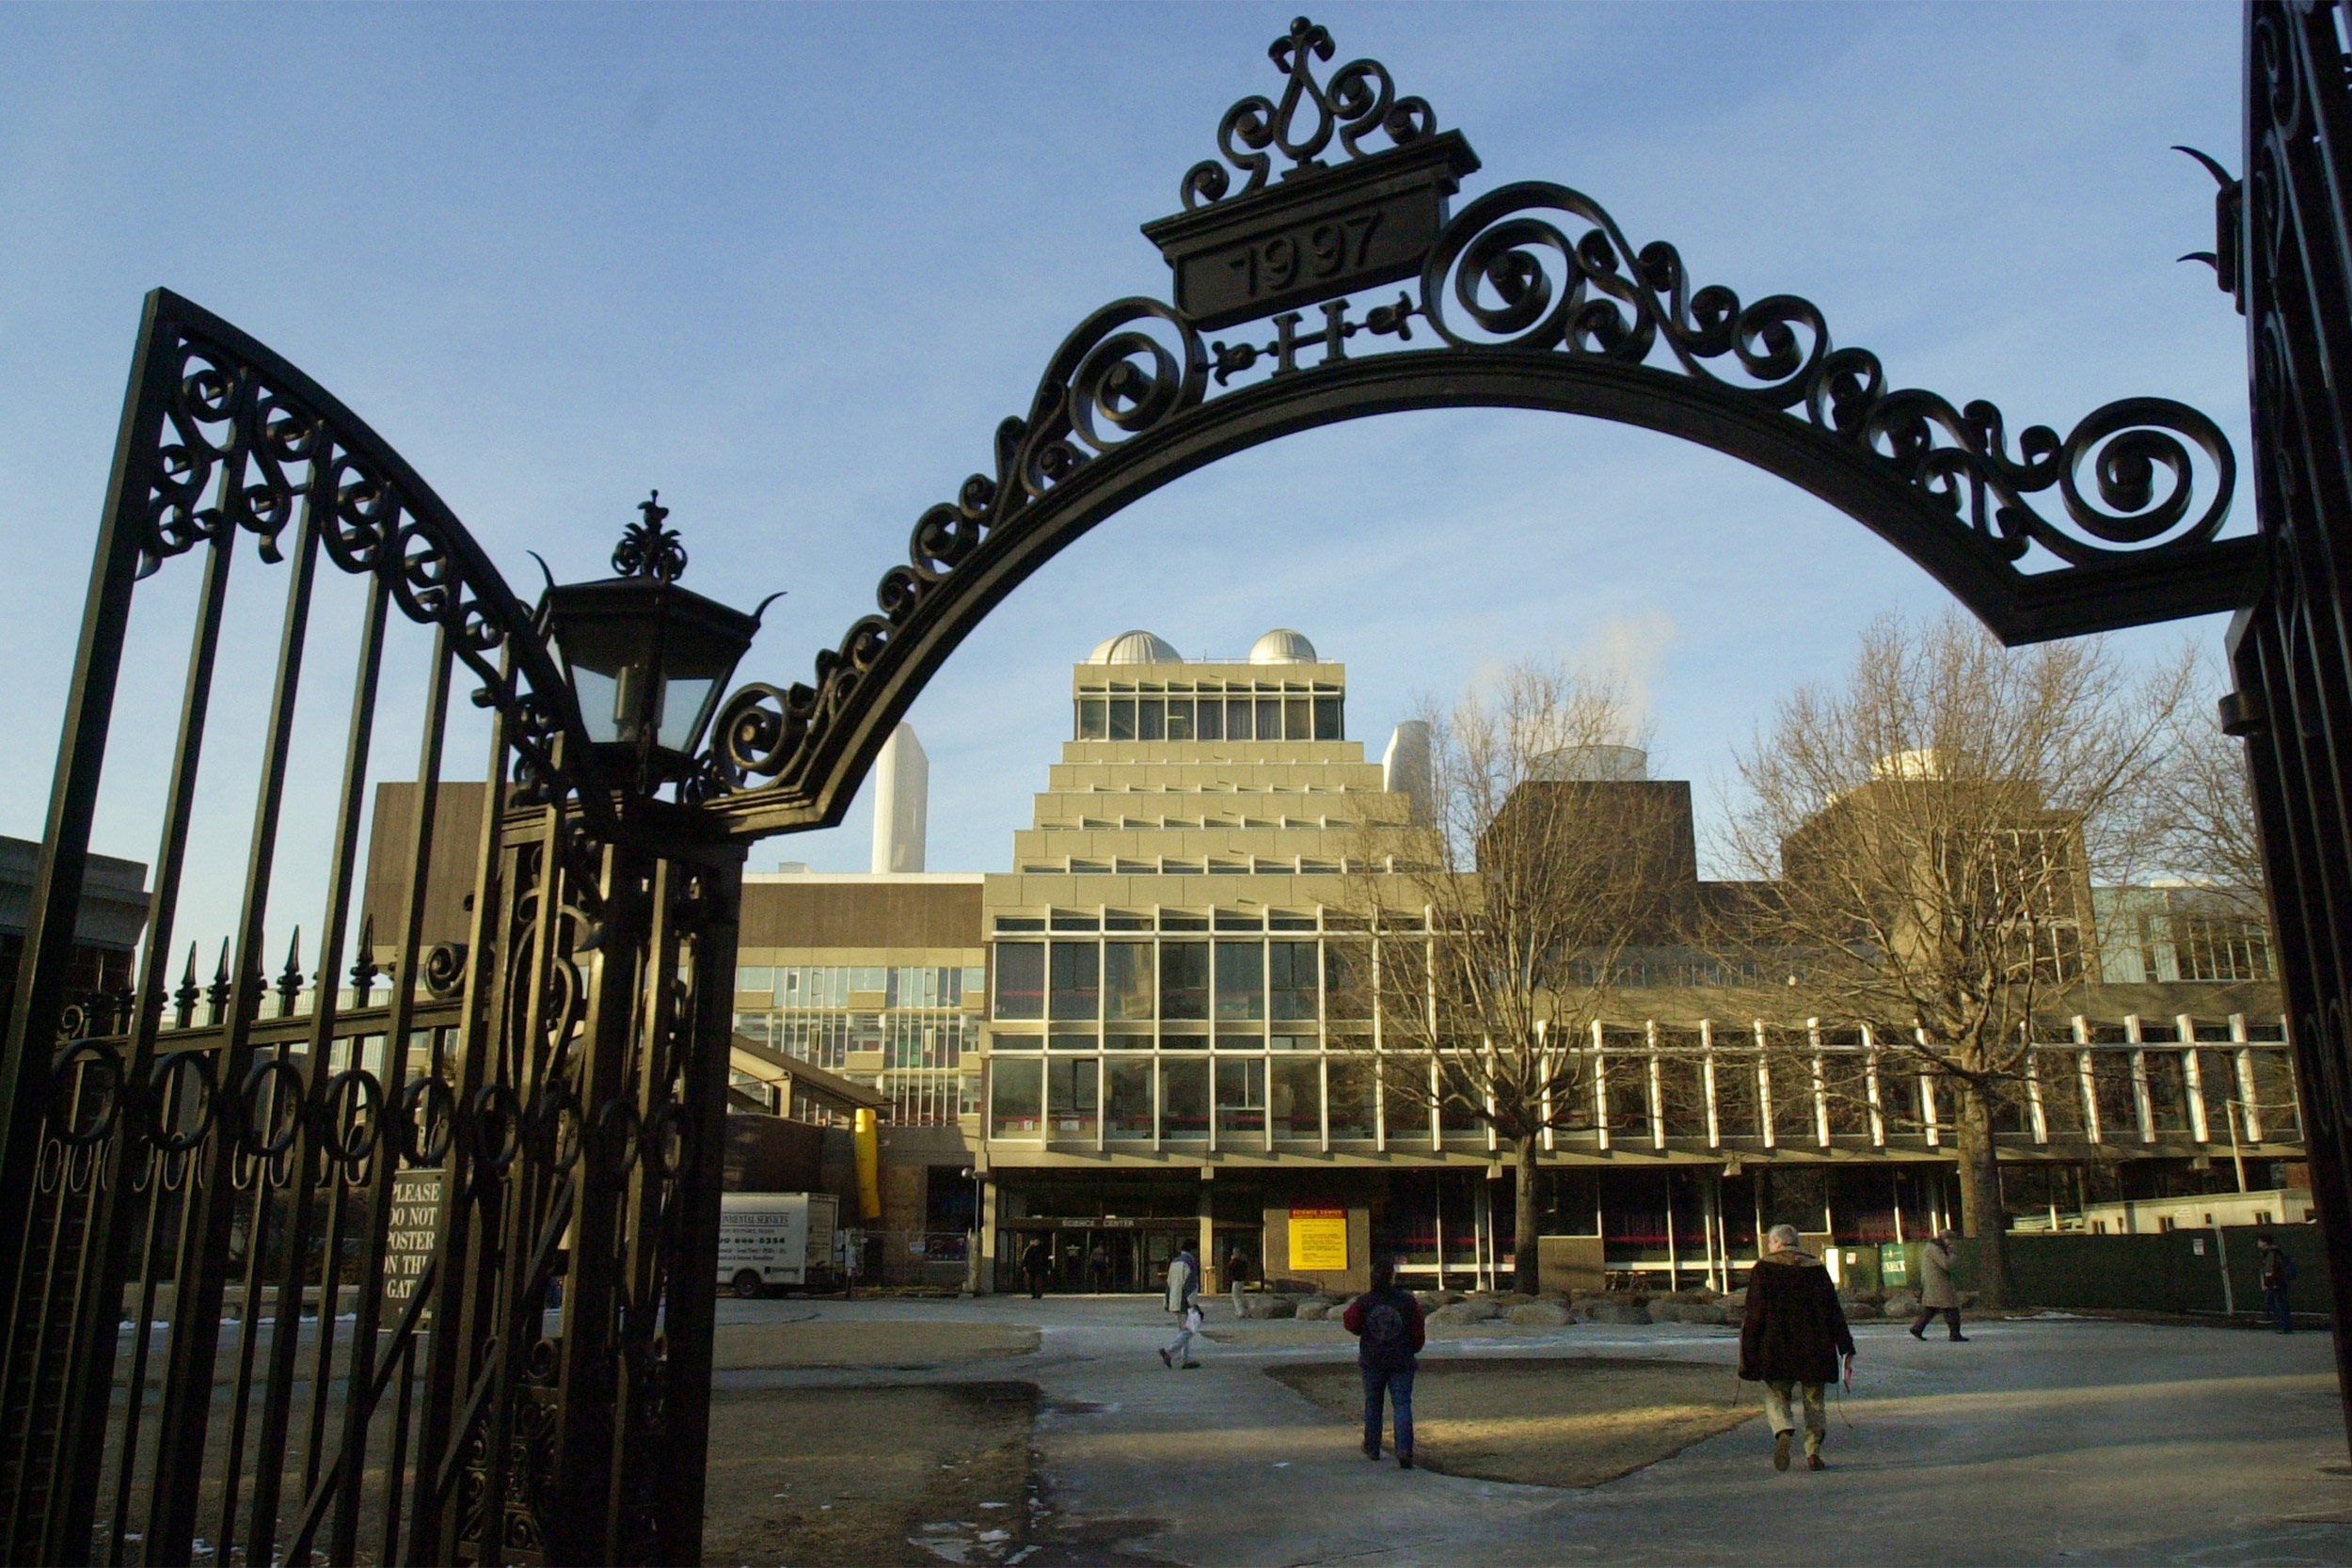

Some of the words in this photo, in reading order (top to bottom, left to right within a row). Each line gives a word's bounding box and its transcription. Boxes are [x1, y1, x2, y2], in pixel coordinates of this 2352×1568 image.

[1229, 210, 1384, 297] 1997
[408, 1206, 438, 1227] NOT
[387, 1278, 418, 1299] GAT
